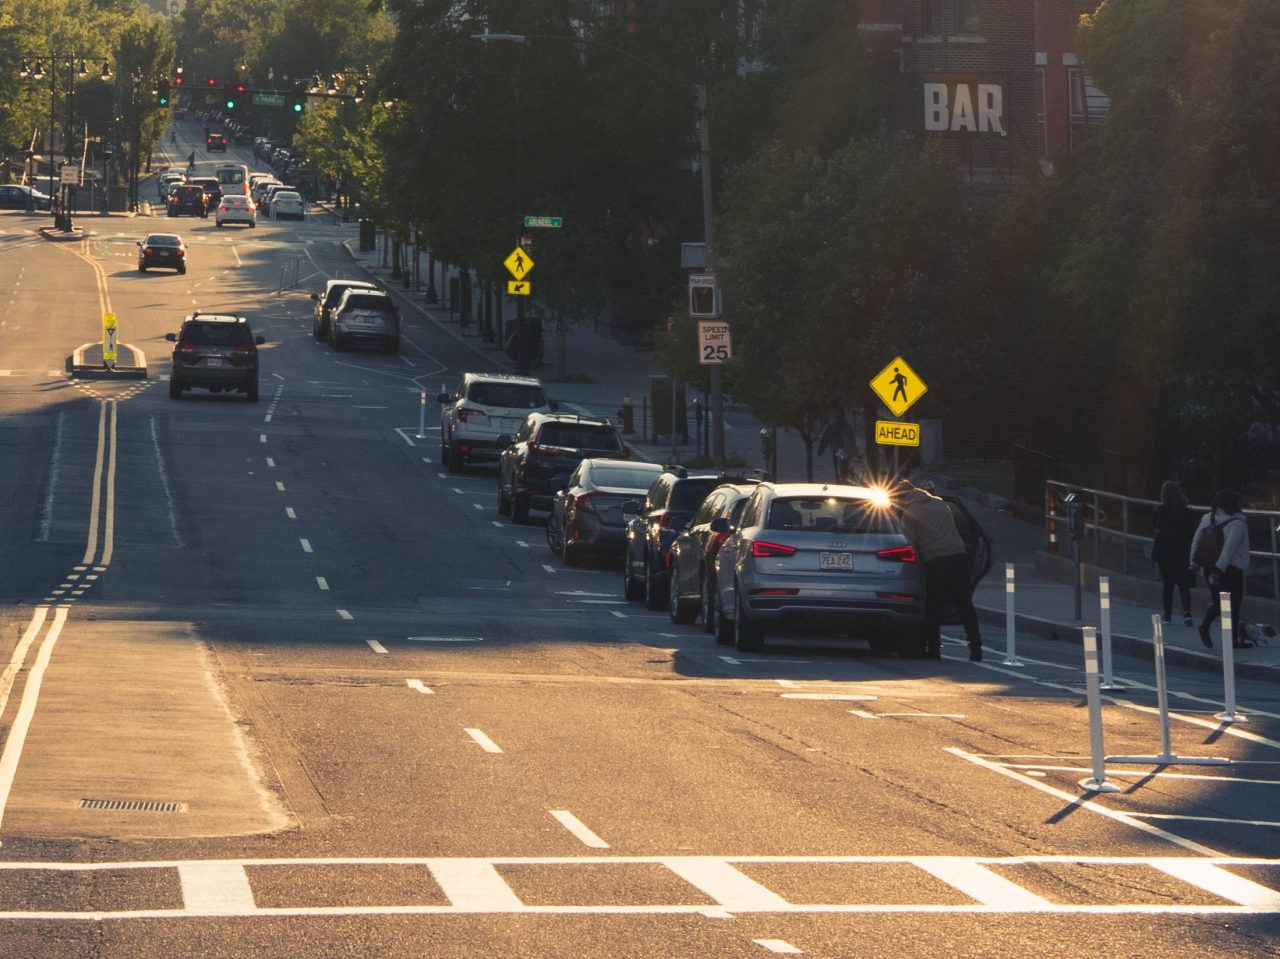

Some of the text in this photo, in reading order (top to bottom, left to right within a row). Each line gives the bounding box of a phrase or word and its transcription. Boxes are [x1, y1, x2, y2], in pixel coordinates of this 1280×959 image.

[924, 83, 1004, 132] BAR
[705, 333, 724, 341] LIMIT
[703, 345, 728, 360] 25
[879, 427, 916, 440] AHEAD
